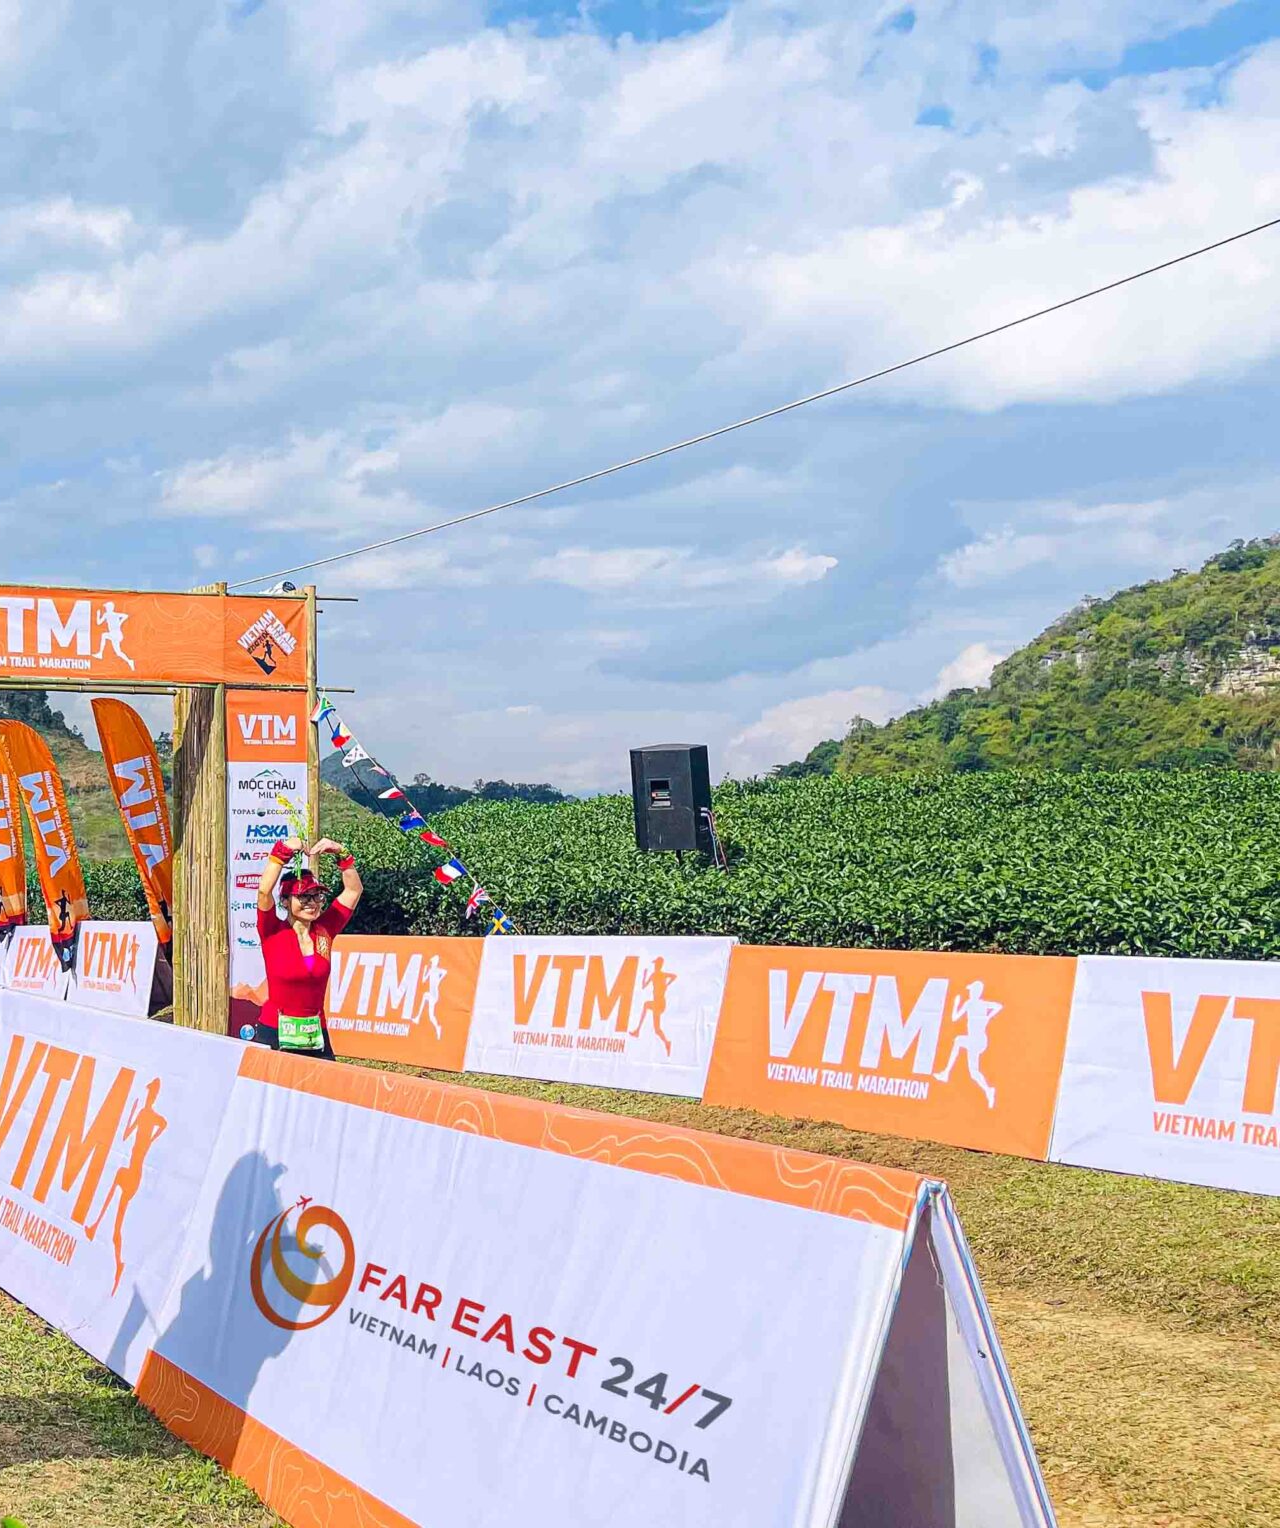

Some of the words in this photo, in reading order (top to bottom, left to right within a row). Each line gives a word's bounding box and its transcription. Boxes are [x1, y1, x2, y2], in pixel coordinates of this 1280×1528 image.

[237, 609, 276, 650] VIETNAM
[9, 656, 36, 668] TRAIL
[39, 657, 91, 670] MARATHON
[237, 714, 297, 740] VTM
[144, 755, 157, 798] MARATHON
[238, 777, 264, 792] MỘC
[267, 778, 296, 790] CHÂU
[18, 772, 68, 878] VTM
[113, 756, 164, 878] VTM
[246, 824, 289, 837] HOKA
[14, 937, 54, 978] VTM
[83, 931, 128, 979] VTM
[330, 951, 422, 1019] VTM
[512, 953, 639, 1032] VTM
[327, 1016, 354, 1032] VIETNAM
[355, 1019, 372, 1033] TRAIL
[373, 1021, 410, 1037] MARATHON
[513, 1031, 548, 1047] VIETNAM
[550, 1033, 574, 1049] TRAIL
[576, 1036, 625, 1053] MARATHON
[768, 969, 949, 1075] VTM
[1141, 991, 1280, 1115] VT
[767, 1063, 818, 1085] VIETNAM
[820, 1069, 853, 1091] TRAIL
[857, 1073, 929, 1100] MARATHON
[1152, 1111, 1236, 1141] VIETNAM
[1241, 1118, 1280, 1148] TRA
[0, 1198, 24, 1234] TRAIL
[22, 1211, 78, 1267] MARATHON
[358, 1262, 443, 1322] FAR
[451, 1298, 598, 1379] EAST
[600, 1356, 733, 1431] 24/7
[348, 1307, 438, 1361] VIETNAM
[456, 1354, 521, 1397] LAOS
[543, 1393, 711, 1484] CAMBODIA
